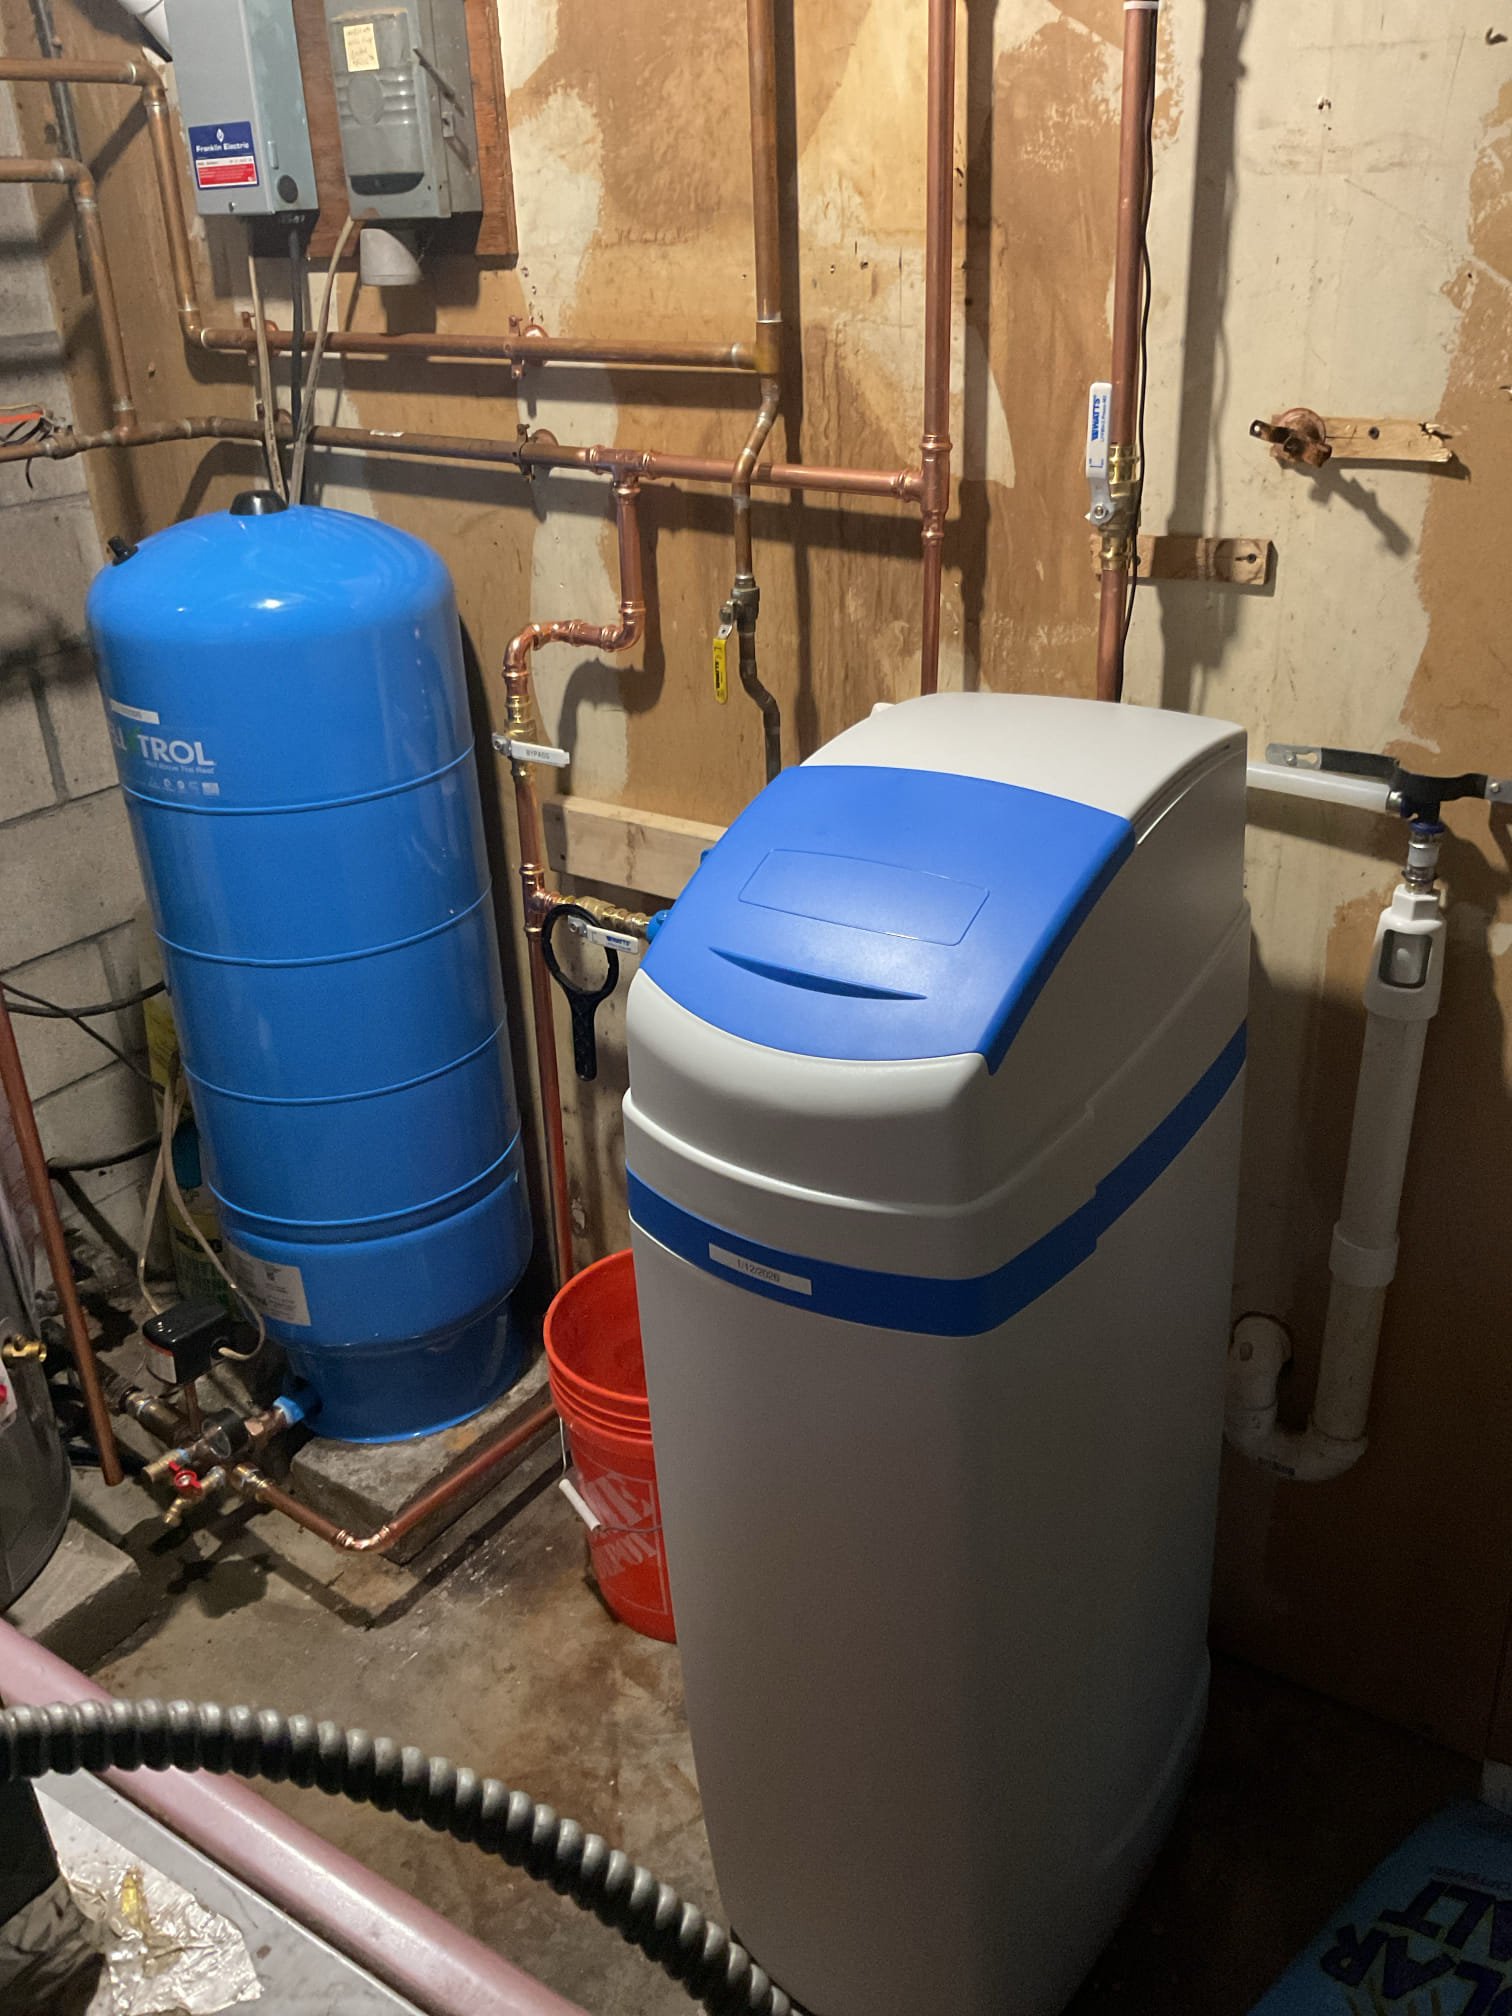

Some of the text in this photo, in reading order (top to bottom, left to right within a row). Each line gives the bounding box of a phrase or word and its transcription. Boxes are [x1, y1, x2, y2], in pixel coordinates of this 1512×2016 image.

[195, 142, 249, 152] Franklin Electric
[1092, 395, 1101, 430] WATTS
